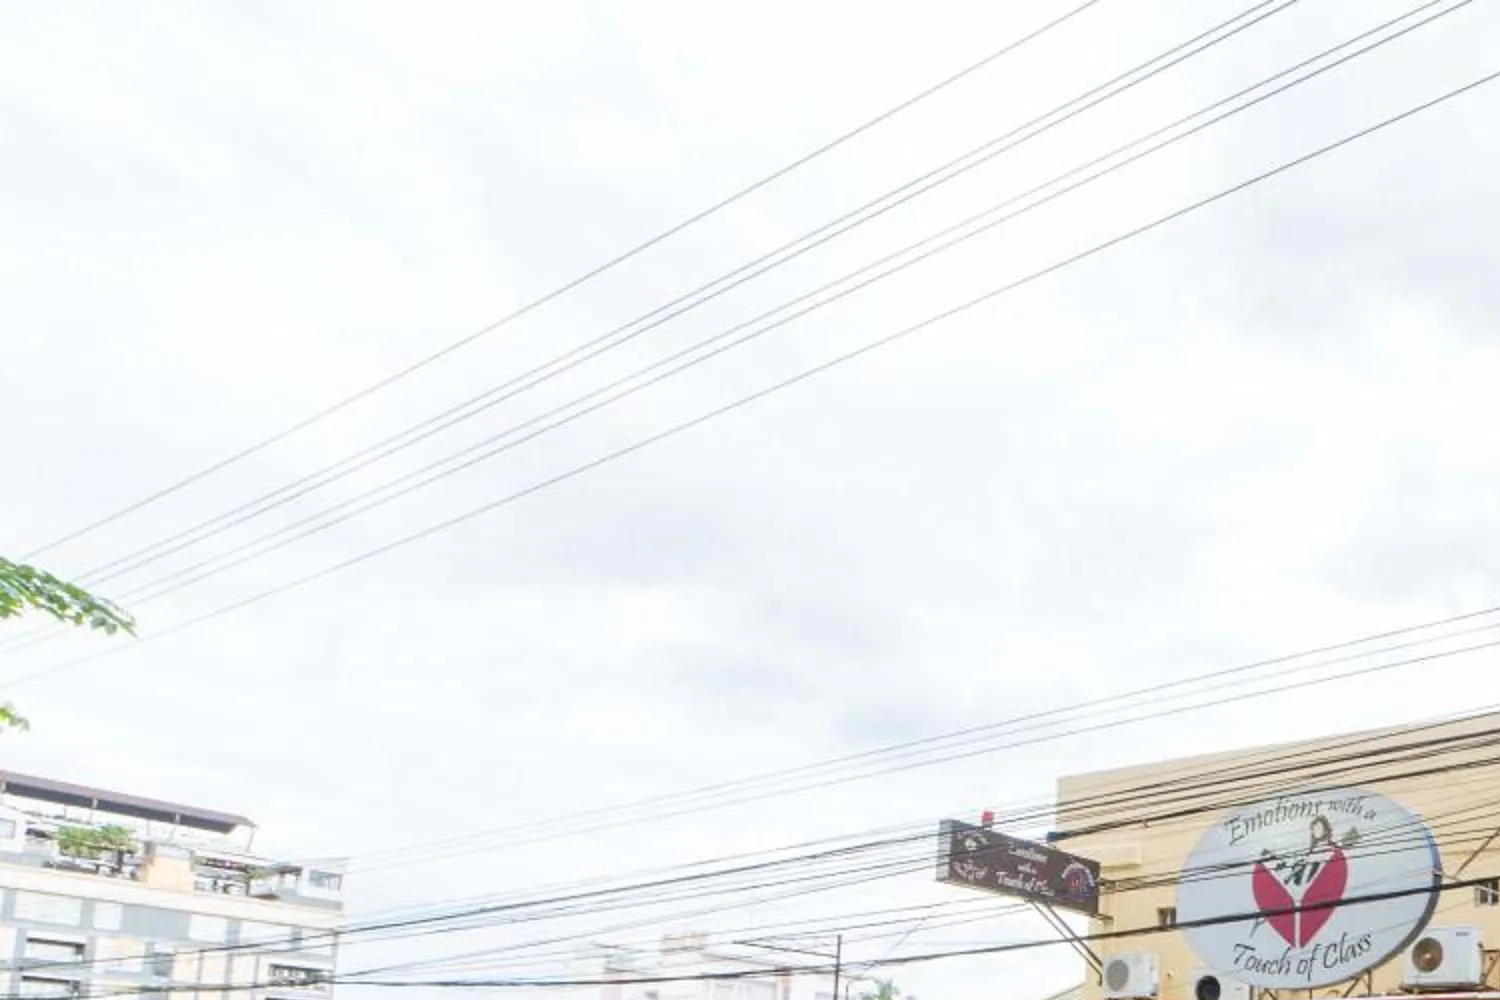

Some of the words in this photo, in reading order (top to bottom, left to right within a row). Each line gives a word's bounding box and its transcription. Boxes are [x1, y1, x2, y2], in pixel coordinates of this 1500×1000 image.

[1224, 796, 1322, 845] Emotions
[1328, 796, 1363, 817] with
[1233, 943, 1291, 975] Touch
[1297, 943, 1322, 981] of
[1323, 930, 1373, 969] Class
